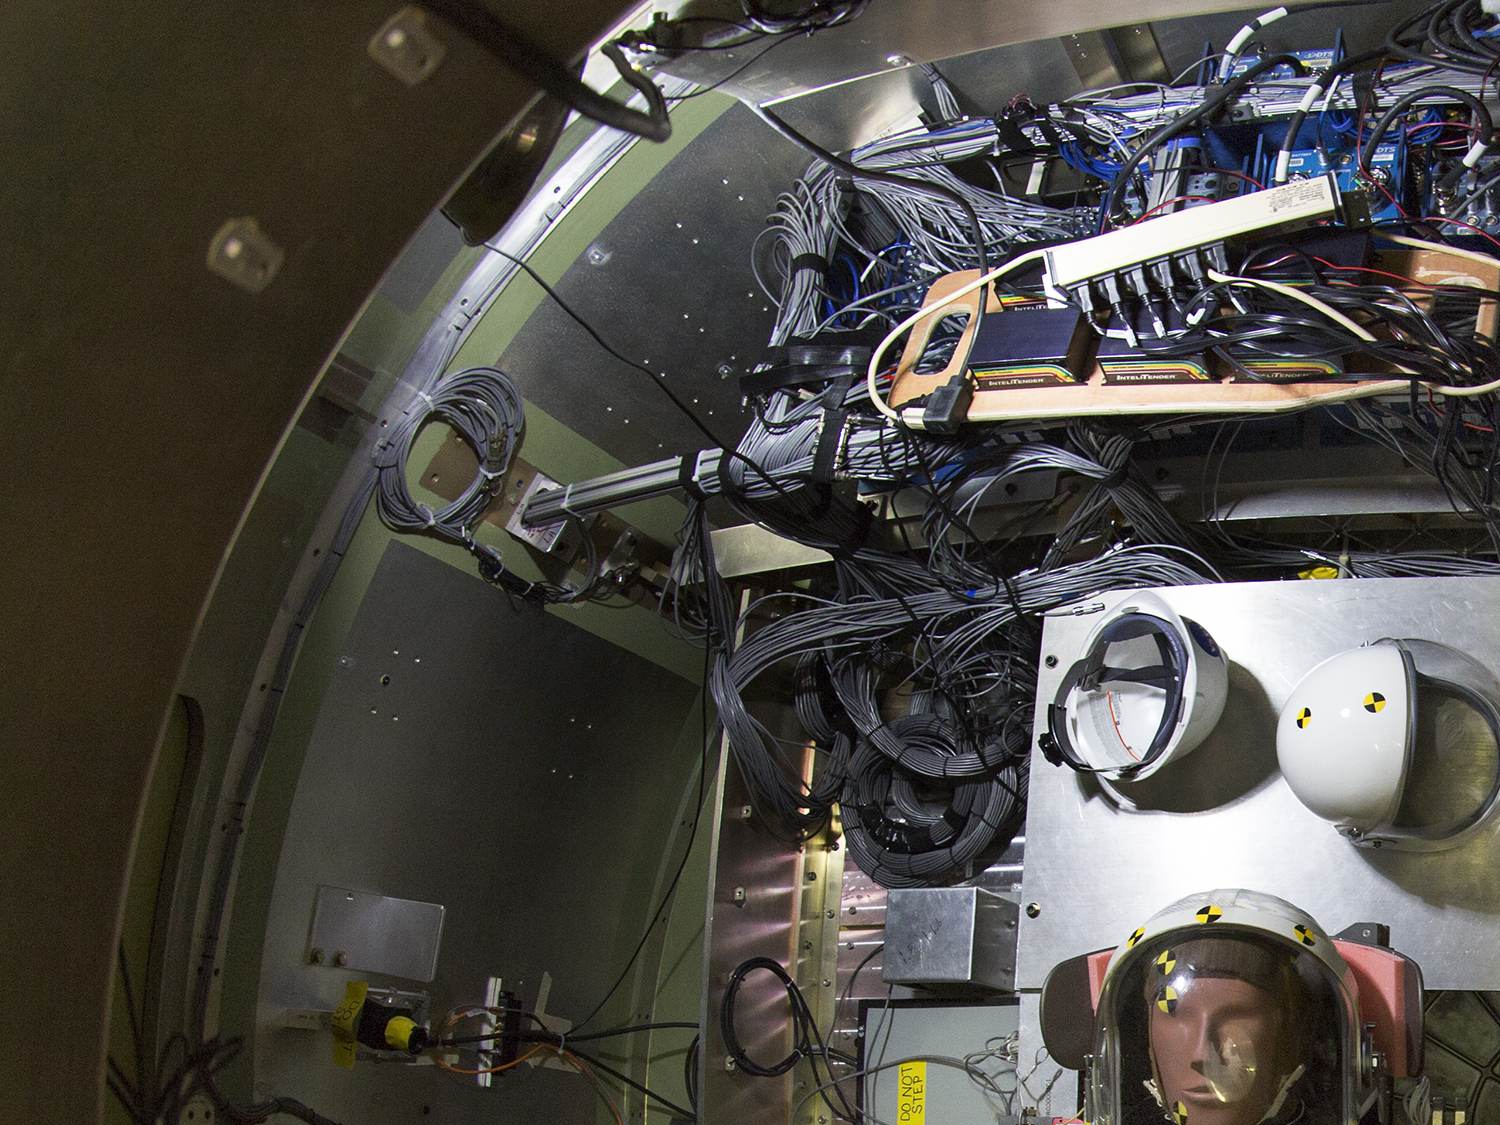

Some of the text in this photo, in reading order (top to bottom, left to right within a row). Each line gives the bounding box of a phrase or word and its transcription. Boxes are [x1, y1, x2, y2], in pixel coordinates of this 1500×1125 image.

[1376, 146, 1397, 154] DTS
[900, 1066, 913, 1122] DO NOT
[911, 1075, 923, 1114] STEP
